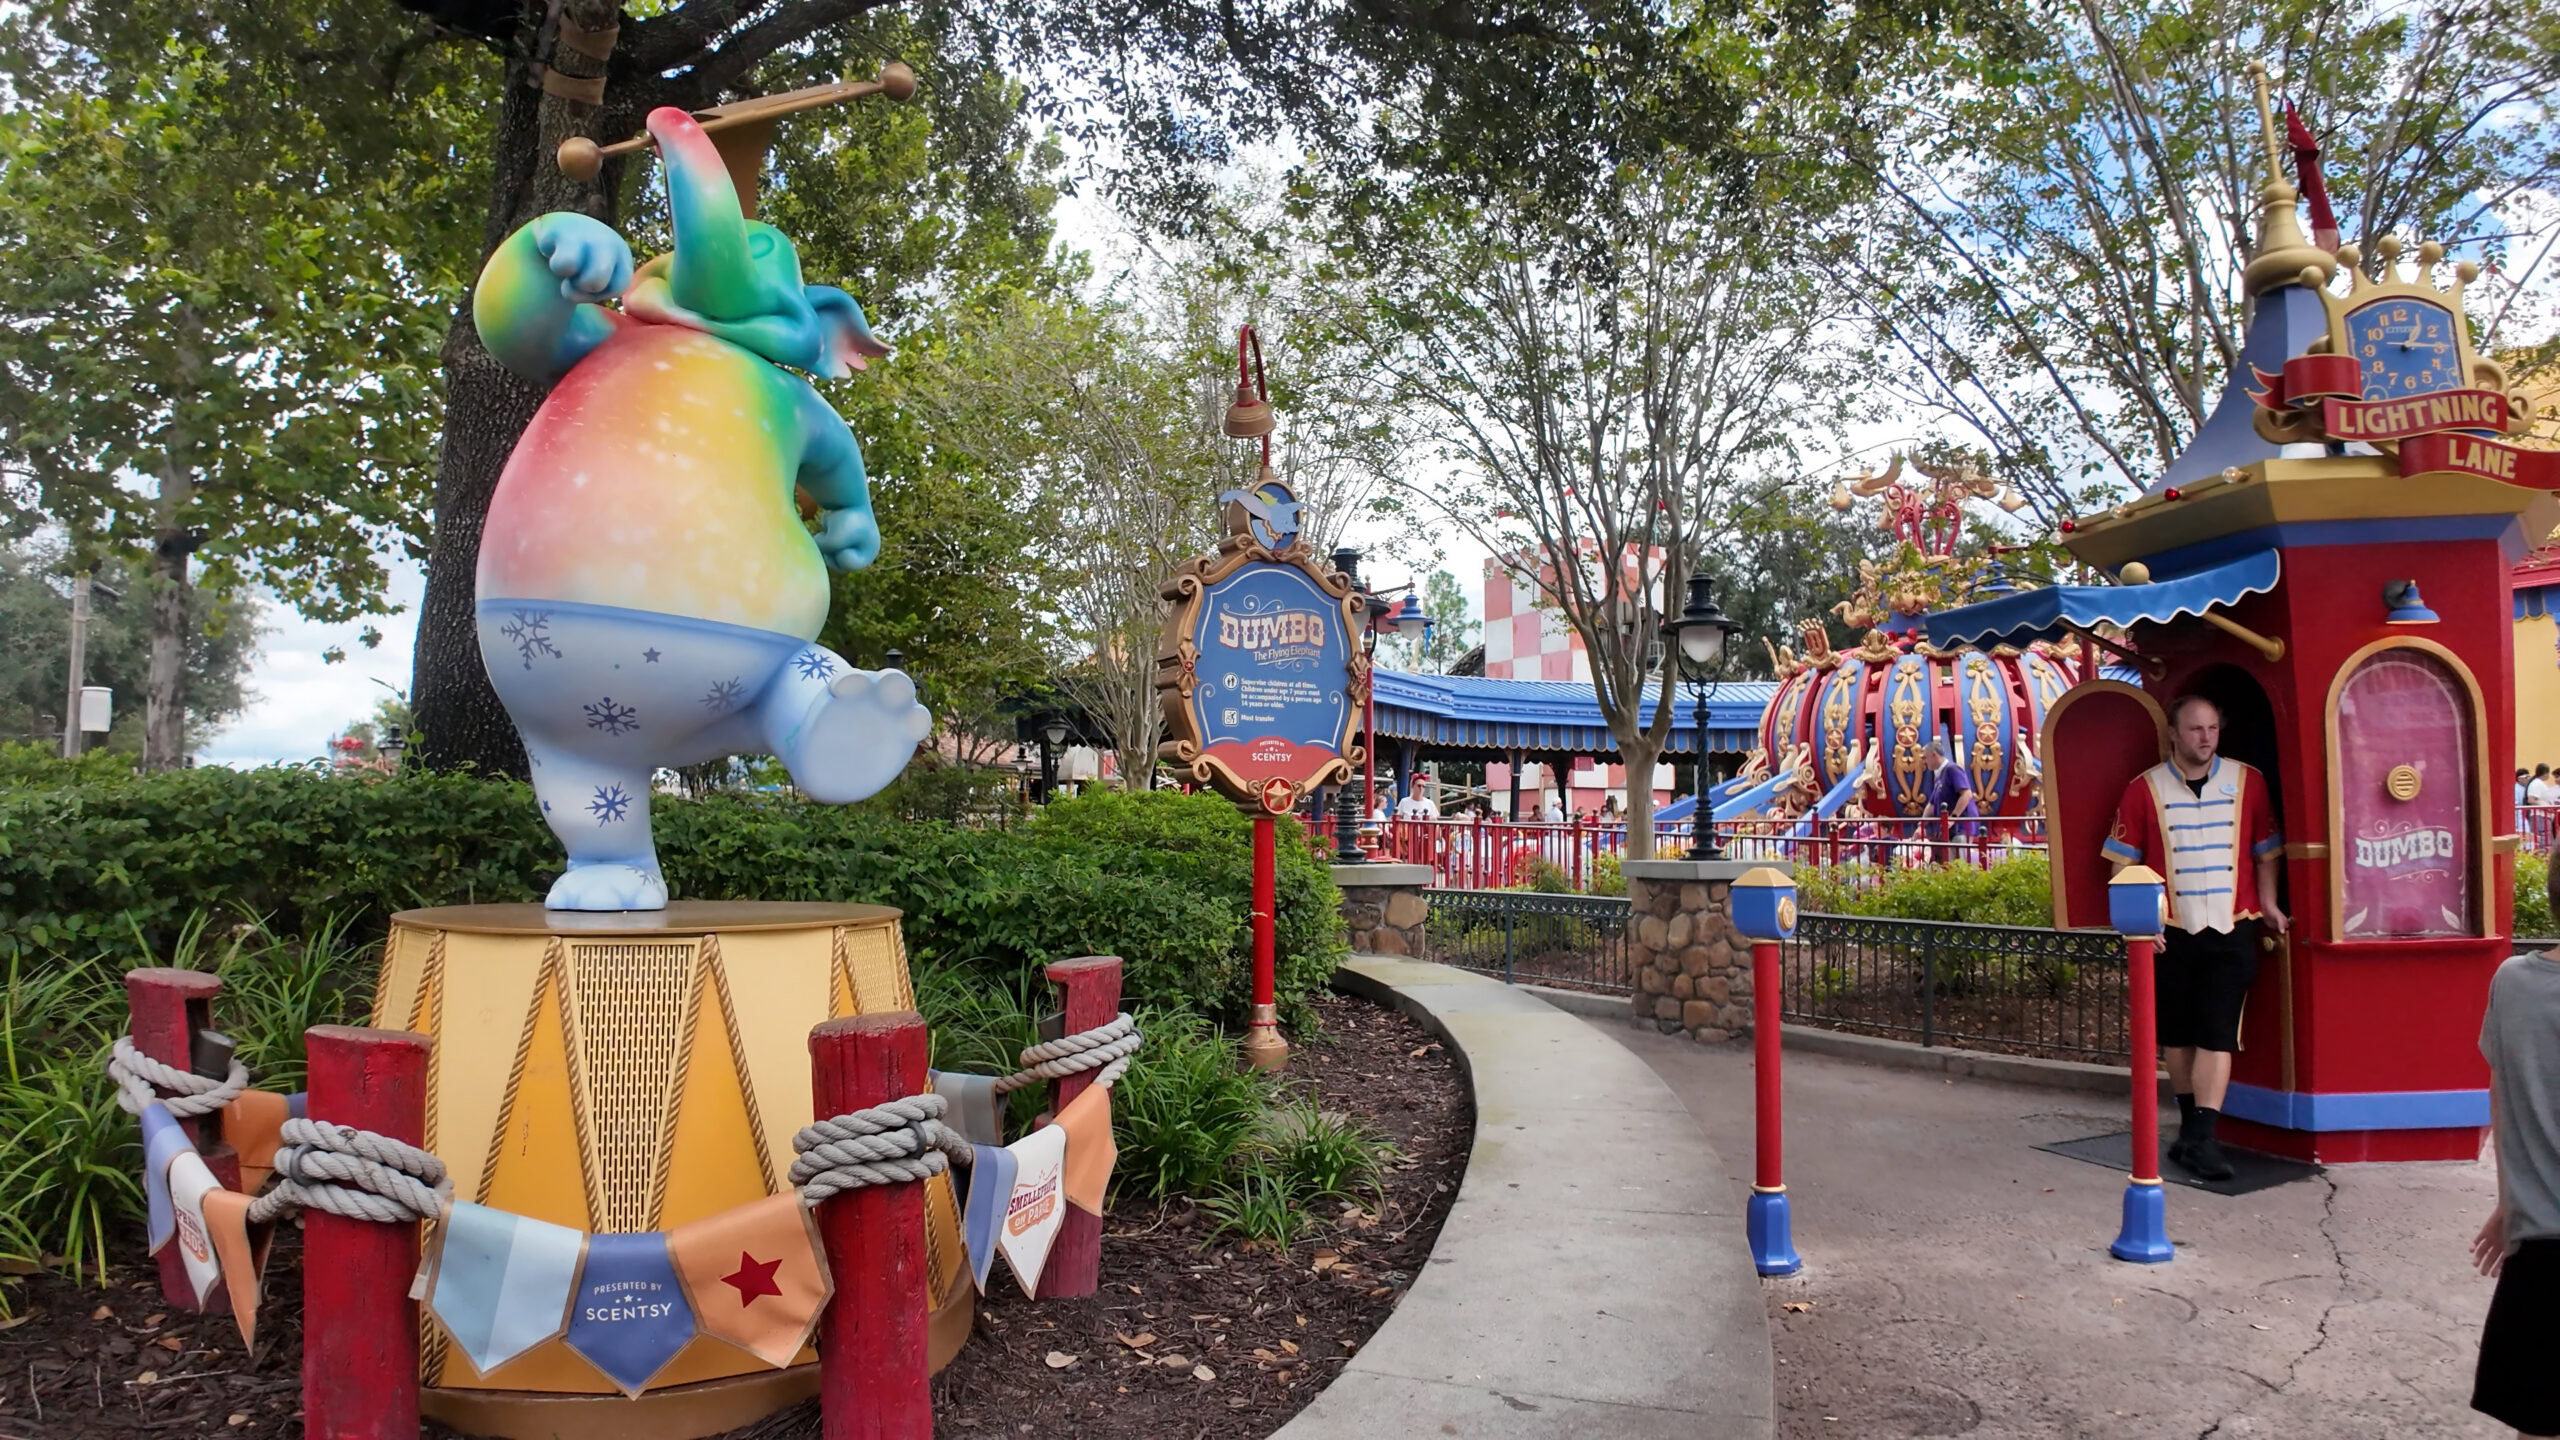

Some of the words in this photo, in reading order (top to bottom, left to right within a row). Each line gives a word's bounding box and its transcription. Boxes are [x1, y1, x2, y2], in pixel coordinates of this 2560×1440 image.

[2380, 314, 2389, 326] 11
[2393, 309, 2407, 321] 12
[2368, 328, 2384, 340] 10
[2427, 325, 2438, 338] 2
[2364, 344, 2376, 357] 9
[2433, 341, 2445, 354] 3
[2372, 360, 2384, 374] 8
[2431, 358, 2441, 370] 4
[2388, 372, 2398, 386] 7
[2404, 376, 2417, 389] 6
[2421, 370, 2432, 384] 5
[2339, 394, 2498, 434] LIGHTNING
[2448, 439, 2517, 479] LANE
[1219, 612, 1325, 650] DUMBO
[1254, 651, 1267, 661] The
[1268, 648, 1289, 660] Flying
[1291, 645, 1320, 659] Elephant
[1252, 752, 1292, 762] SCENTSY
[2355, 830, 2454, 868] DUMBO
[1015, 1214, 1026, 1227] ON
[594, 1281, 647, 1296] PRESENTED
[650, 1282, 662, 1291] BY
[586, 1302, 672, 1321] SCENTSY
